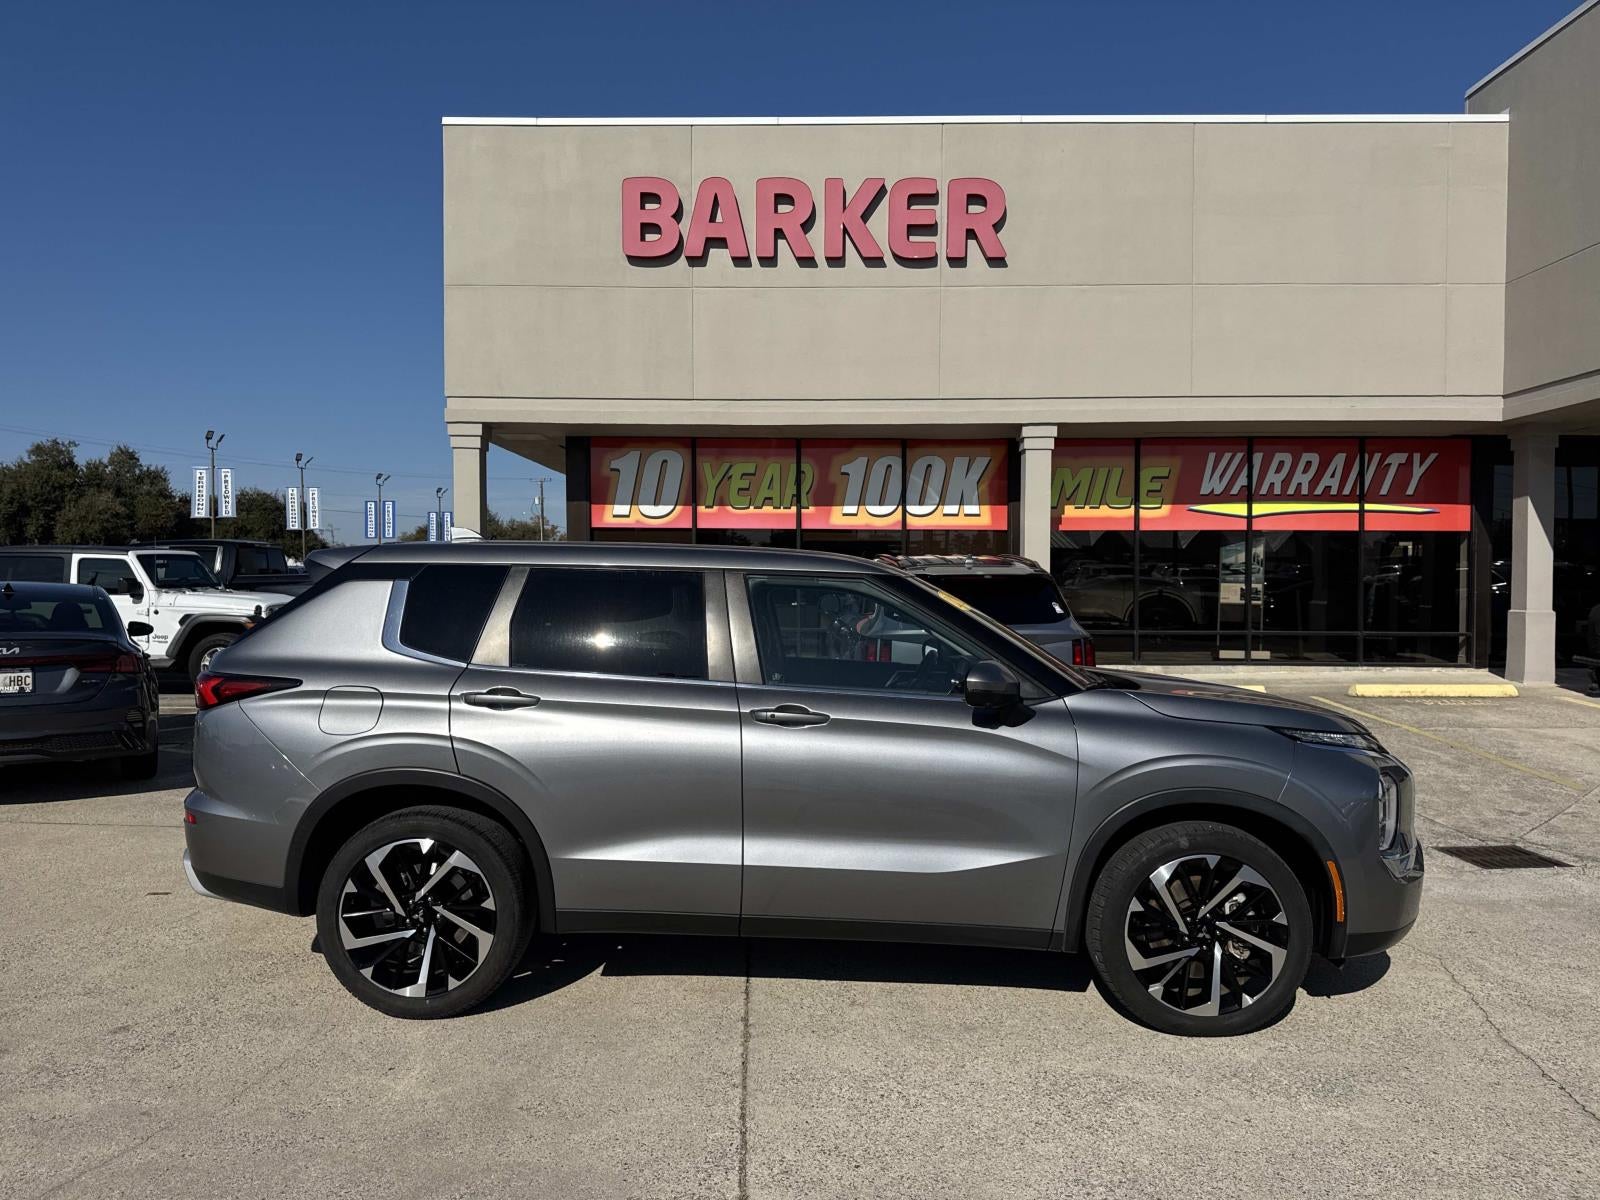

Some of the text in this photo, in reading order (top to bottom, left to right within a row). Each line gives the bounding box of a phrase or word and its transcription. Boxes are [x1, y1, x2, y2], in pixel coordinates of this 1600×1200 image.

[622, 176, 1008, 261] BARKER
[609, 450, 1439, 518] 10 YEAR 100K MILE WARRANTY
[152, 633, 168, 641] Jeep
[9, 675, 31, 688] HBC
